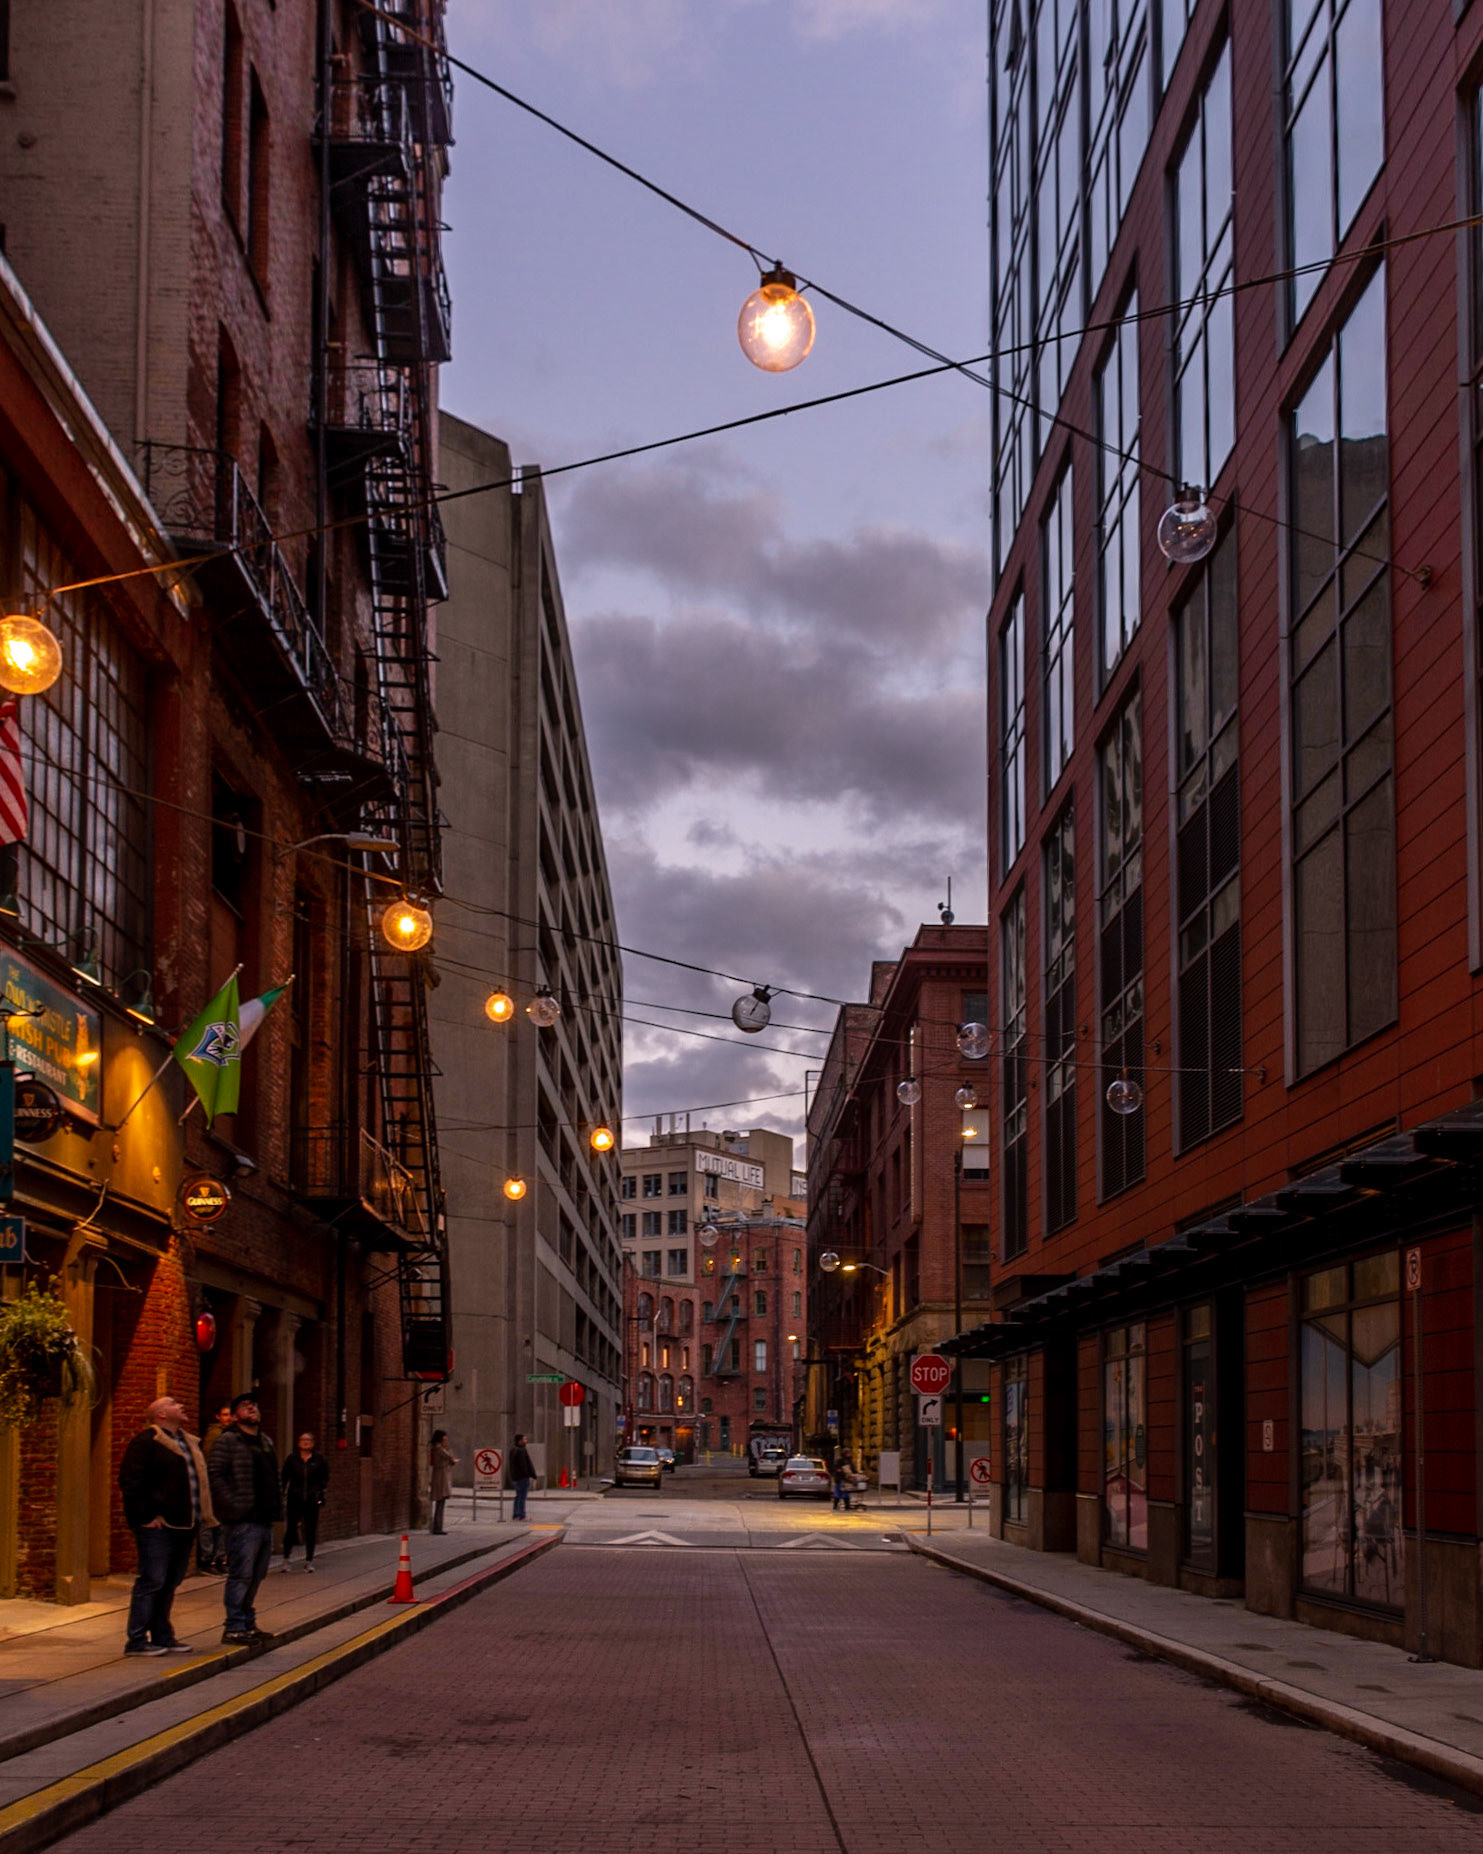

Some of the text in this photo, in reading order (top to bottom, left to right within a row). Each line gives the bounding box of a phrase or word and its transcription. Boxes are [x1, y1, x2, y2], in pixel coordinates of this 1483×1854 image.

[16, 1044, 68, 1086] RESTAURANT
[12, 1107, 53, 1119] UINNESS
[698, 1153, 761, 1185] MUTUAL LIFE
[187, 1196, 223, 1206] GUINNESS
[913, 1366, 948, 1382] STOP
[921, 1416, 939, 1424] ONLY
[1193, 1401, 1204, 1521] POST
